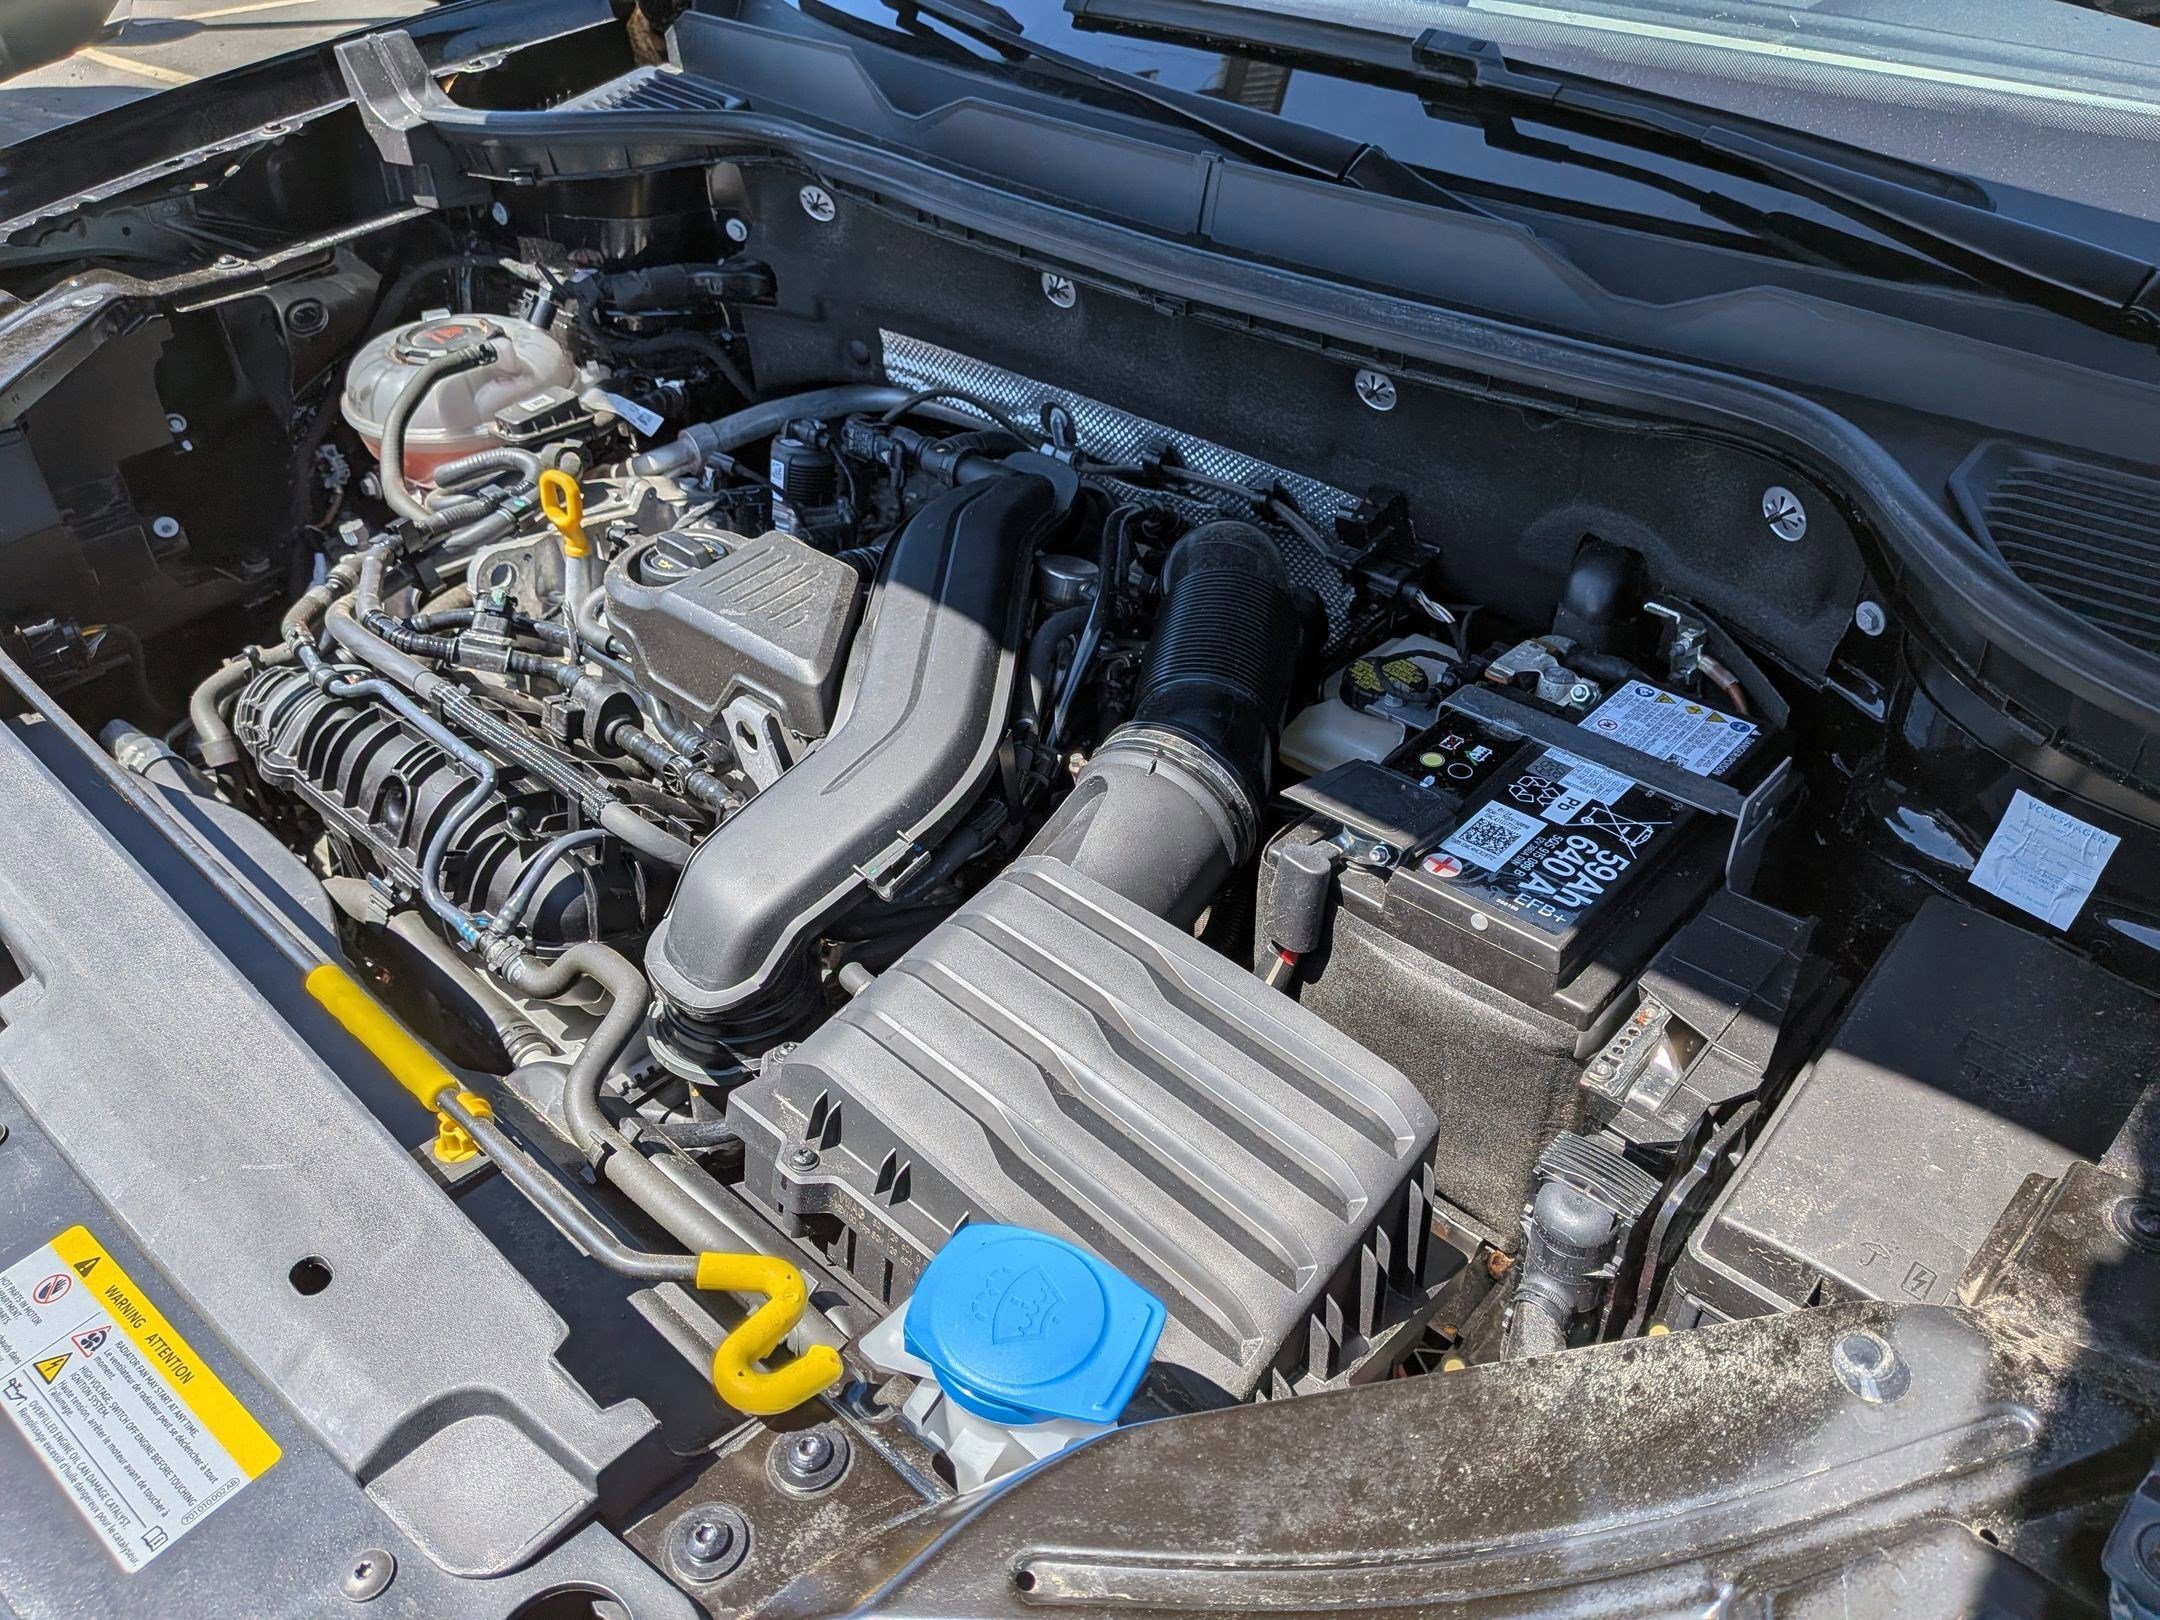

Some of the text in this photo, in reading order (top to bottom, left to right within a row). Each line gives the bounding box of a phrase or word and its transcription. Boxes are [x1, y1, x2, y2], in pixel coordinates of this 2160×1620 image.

[1557, 797, 1581, 811] Pb
[2028, 801, 2108, 844] VOLKSWAGEN
[1514, 869, 1526, 877] B
[1518, 835, 1599, 895] 640 A
[1520, 858, 1538, 871] 089
[1533, 847, 1550, 860] 915
[1553, 850, 1630, 907] 59Ah
[1513, 893, 1566, 922] EFB+
[7, 1285, 24, 1303] PARTS
[18, 1299, 28, 1308] IN
[23, 1305, 42, 1326] MOTOR
[103, 1283, 195, 1385] WARNING ATTENTION
[93, 1355, 117, 1381] moment.
[114, 1339, 200, 1438] RADIATOR FAN MAY START AT ANY TIME.
[46, 1386, 76, 1419] l'allumage.
[69, 1371, 110, 1419] IGNITION SYSTEM.
[103, 1348, 219, 1484] Le ventilateur de radiateur peut se déclencher à tout
[57, 1379, 171, 1517] Haute tension, arrêter le moteur avant de toucher à
[78, 1364, 197, 1507] HIGH VOLTAGE, SWITCH OFF ENGINE BEFORE TOUCHING
[28, 1399, 132, 1529] OVERFILLED ENGINE OIL CAN DAMAGE CATALYST.
